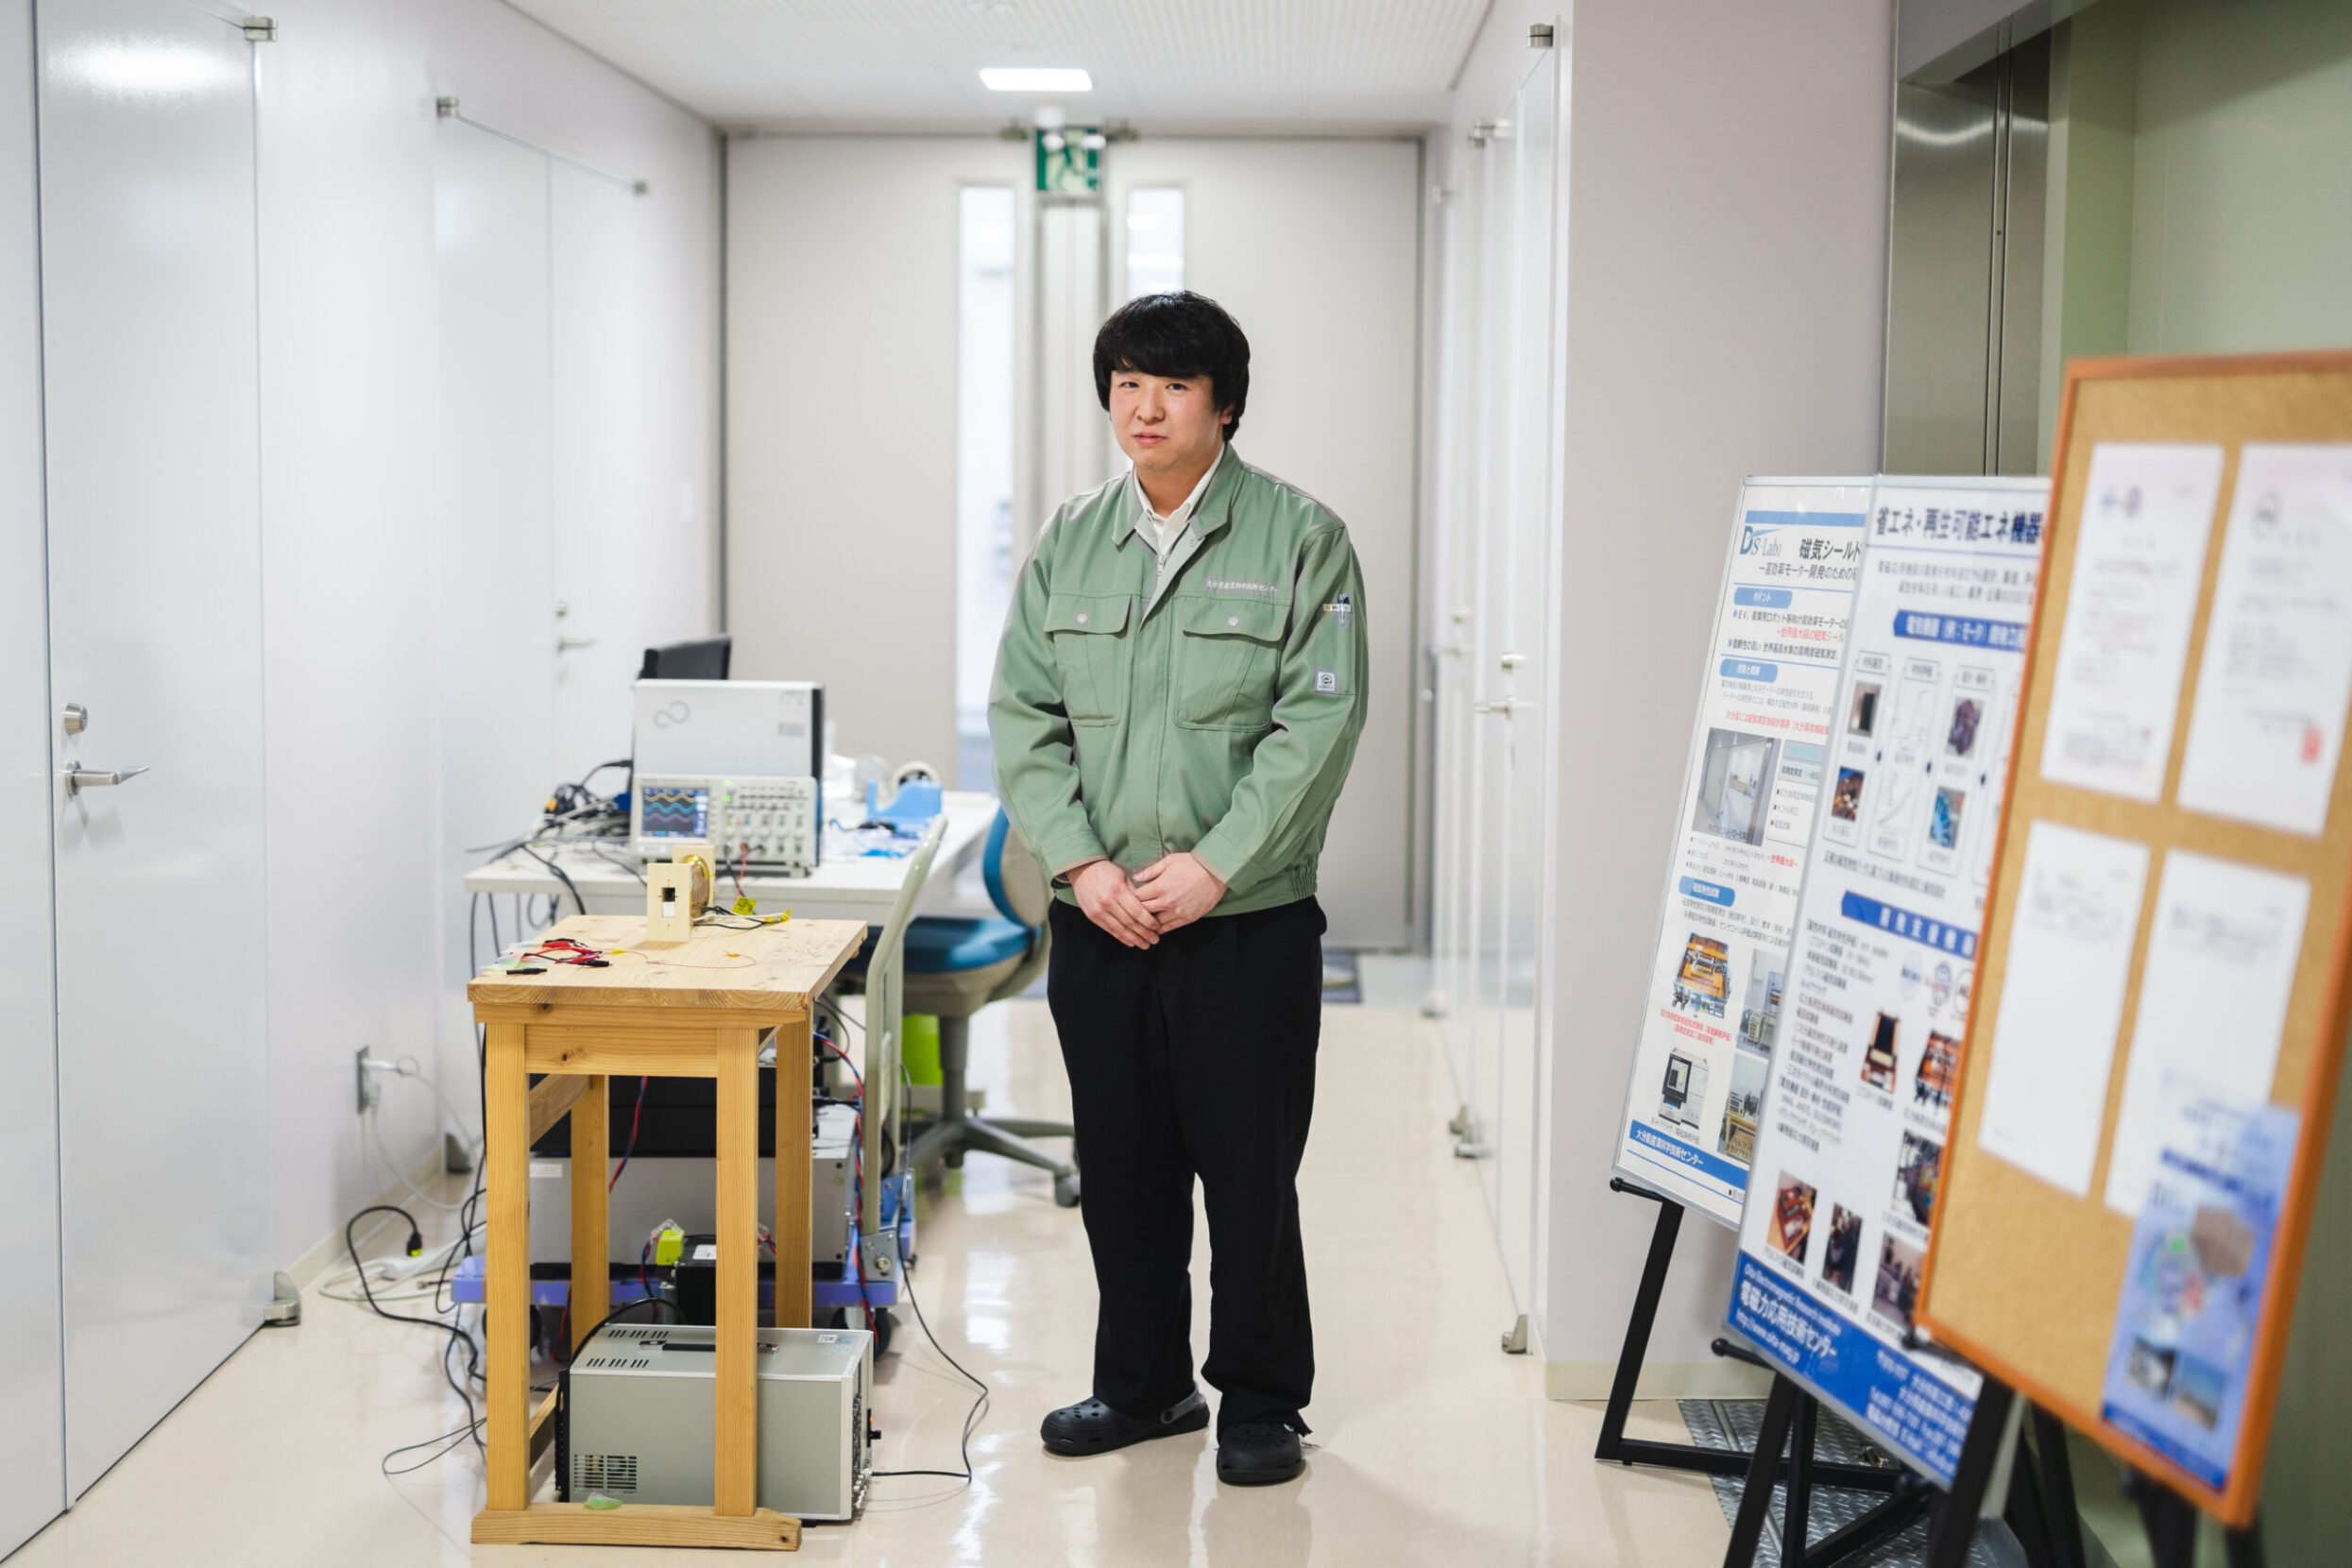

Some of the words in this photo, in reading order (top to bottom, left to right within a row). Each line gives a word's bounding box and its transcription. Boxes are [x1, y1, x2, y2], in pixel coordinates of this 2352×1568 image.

[1636, 1129, 1704, 1166] 大分県産業科学技術センター
